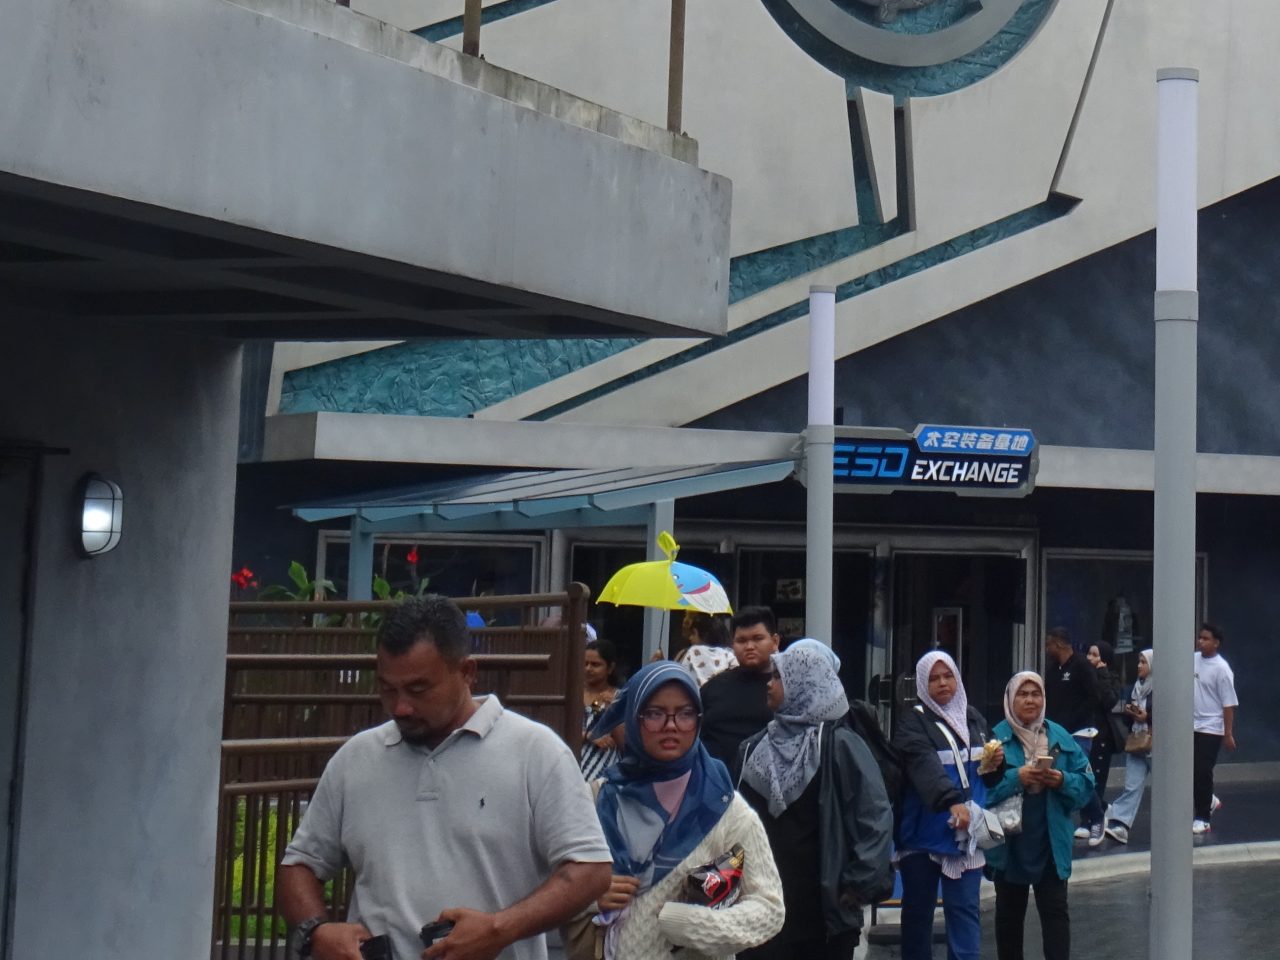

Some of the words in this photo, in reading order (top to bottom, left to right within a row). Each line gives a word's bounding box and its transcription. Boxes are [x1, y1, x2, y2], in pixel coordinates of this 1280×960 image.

[923, 431, 1029, 451] 太空装备基地
[832, 445, 910, 478] ESD
[910, 459, 1023, 484] EXCHANGE
